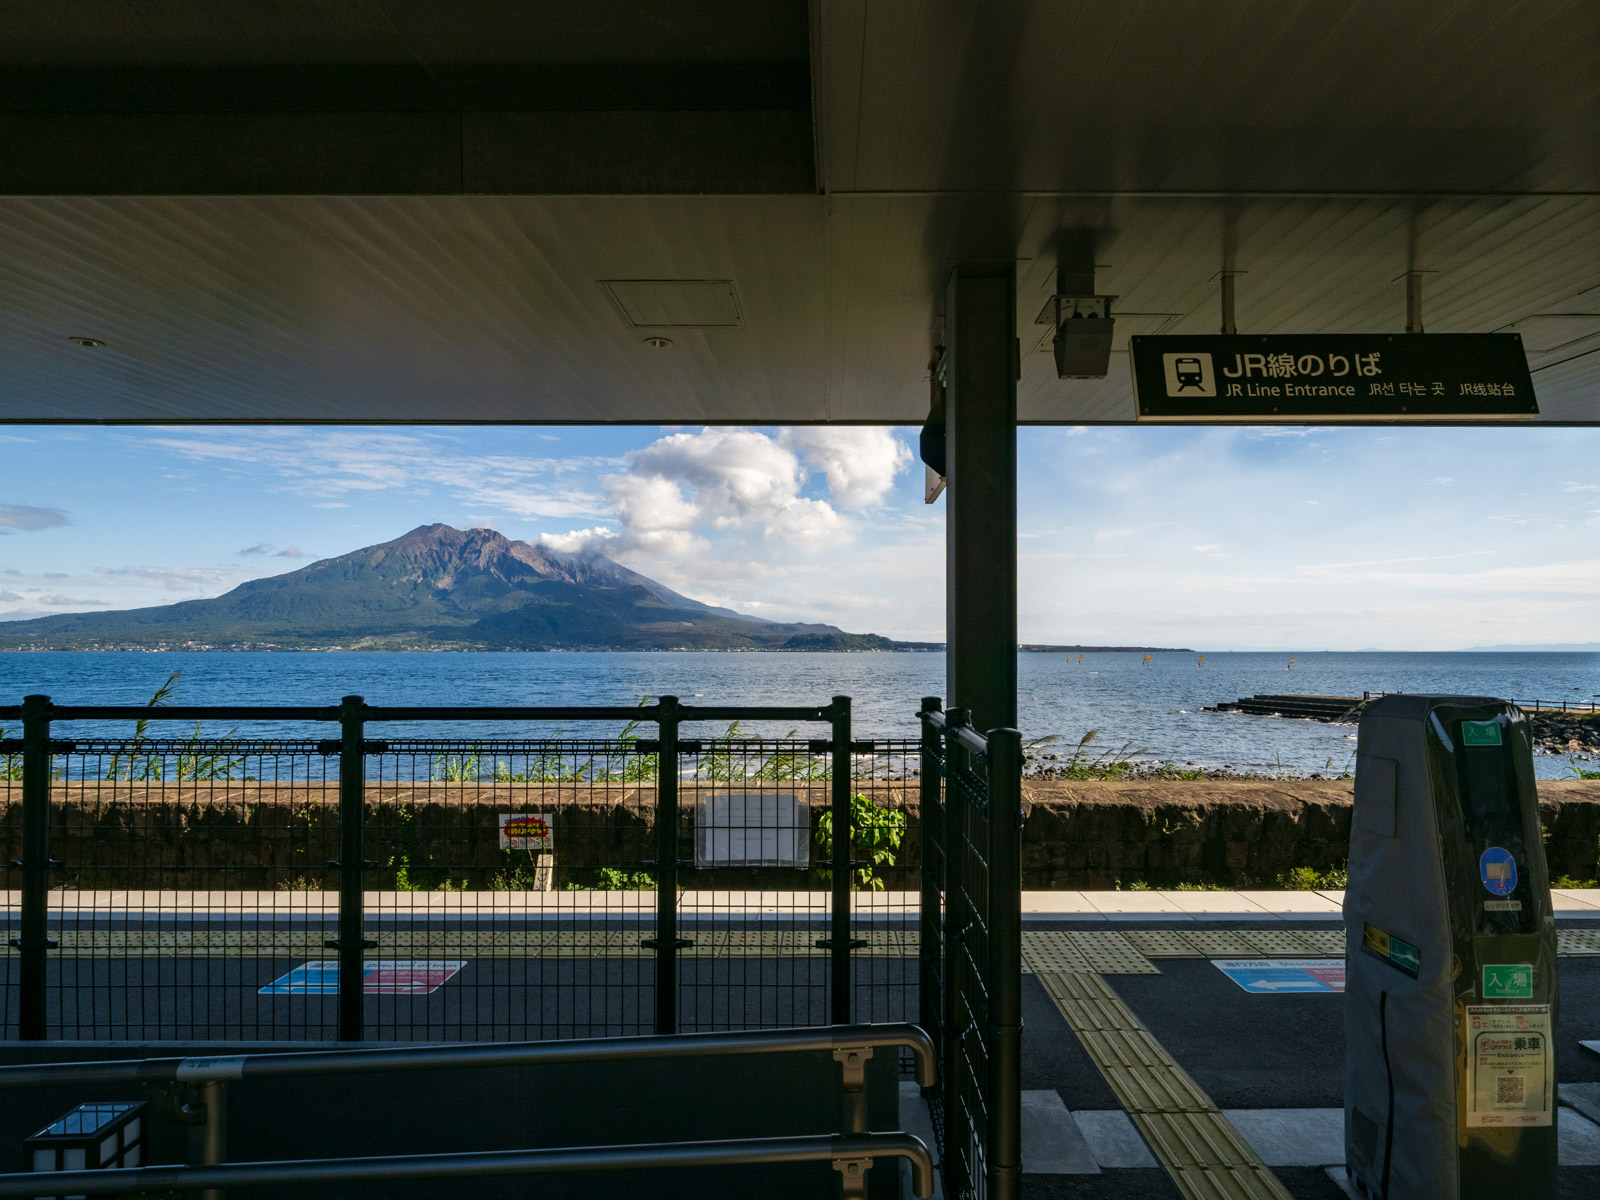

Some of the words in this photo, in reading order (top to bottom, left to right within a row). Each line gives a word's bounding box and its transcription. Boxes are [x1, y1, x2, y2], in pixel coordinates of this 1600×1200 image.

[1223, 352, 1383, 378] JR線のりば
[1225, 383, 1243, 397] JR
[1247, 383, 1281, 397] Line
[1284, 383, 1356, 397] Entrance
[1368, 382, 1396, 396] JR선
[1399, 382, 1427, 396] 타는
[1431, 381, 1446, 396] 곳
[1458, 382, 1516, 397] JR线站台
[1488, 972, 1528, 987] 入場
[1514, 1037, 1541, 1051] 乗車
